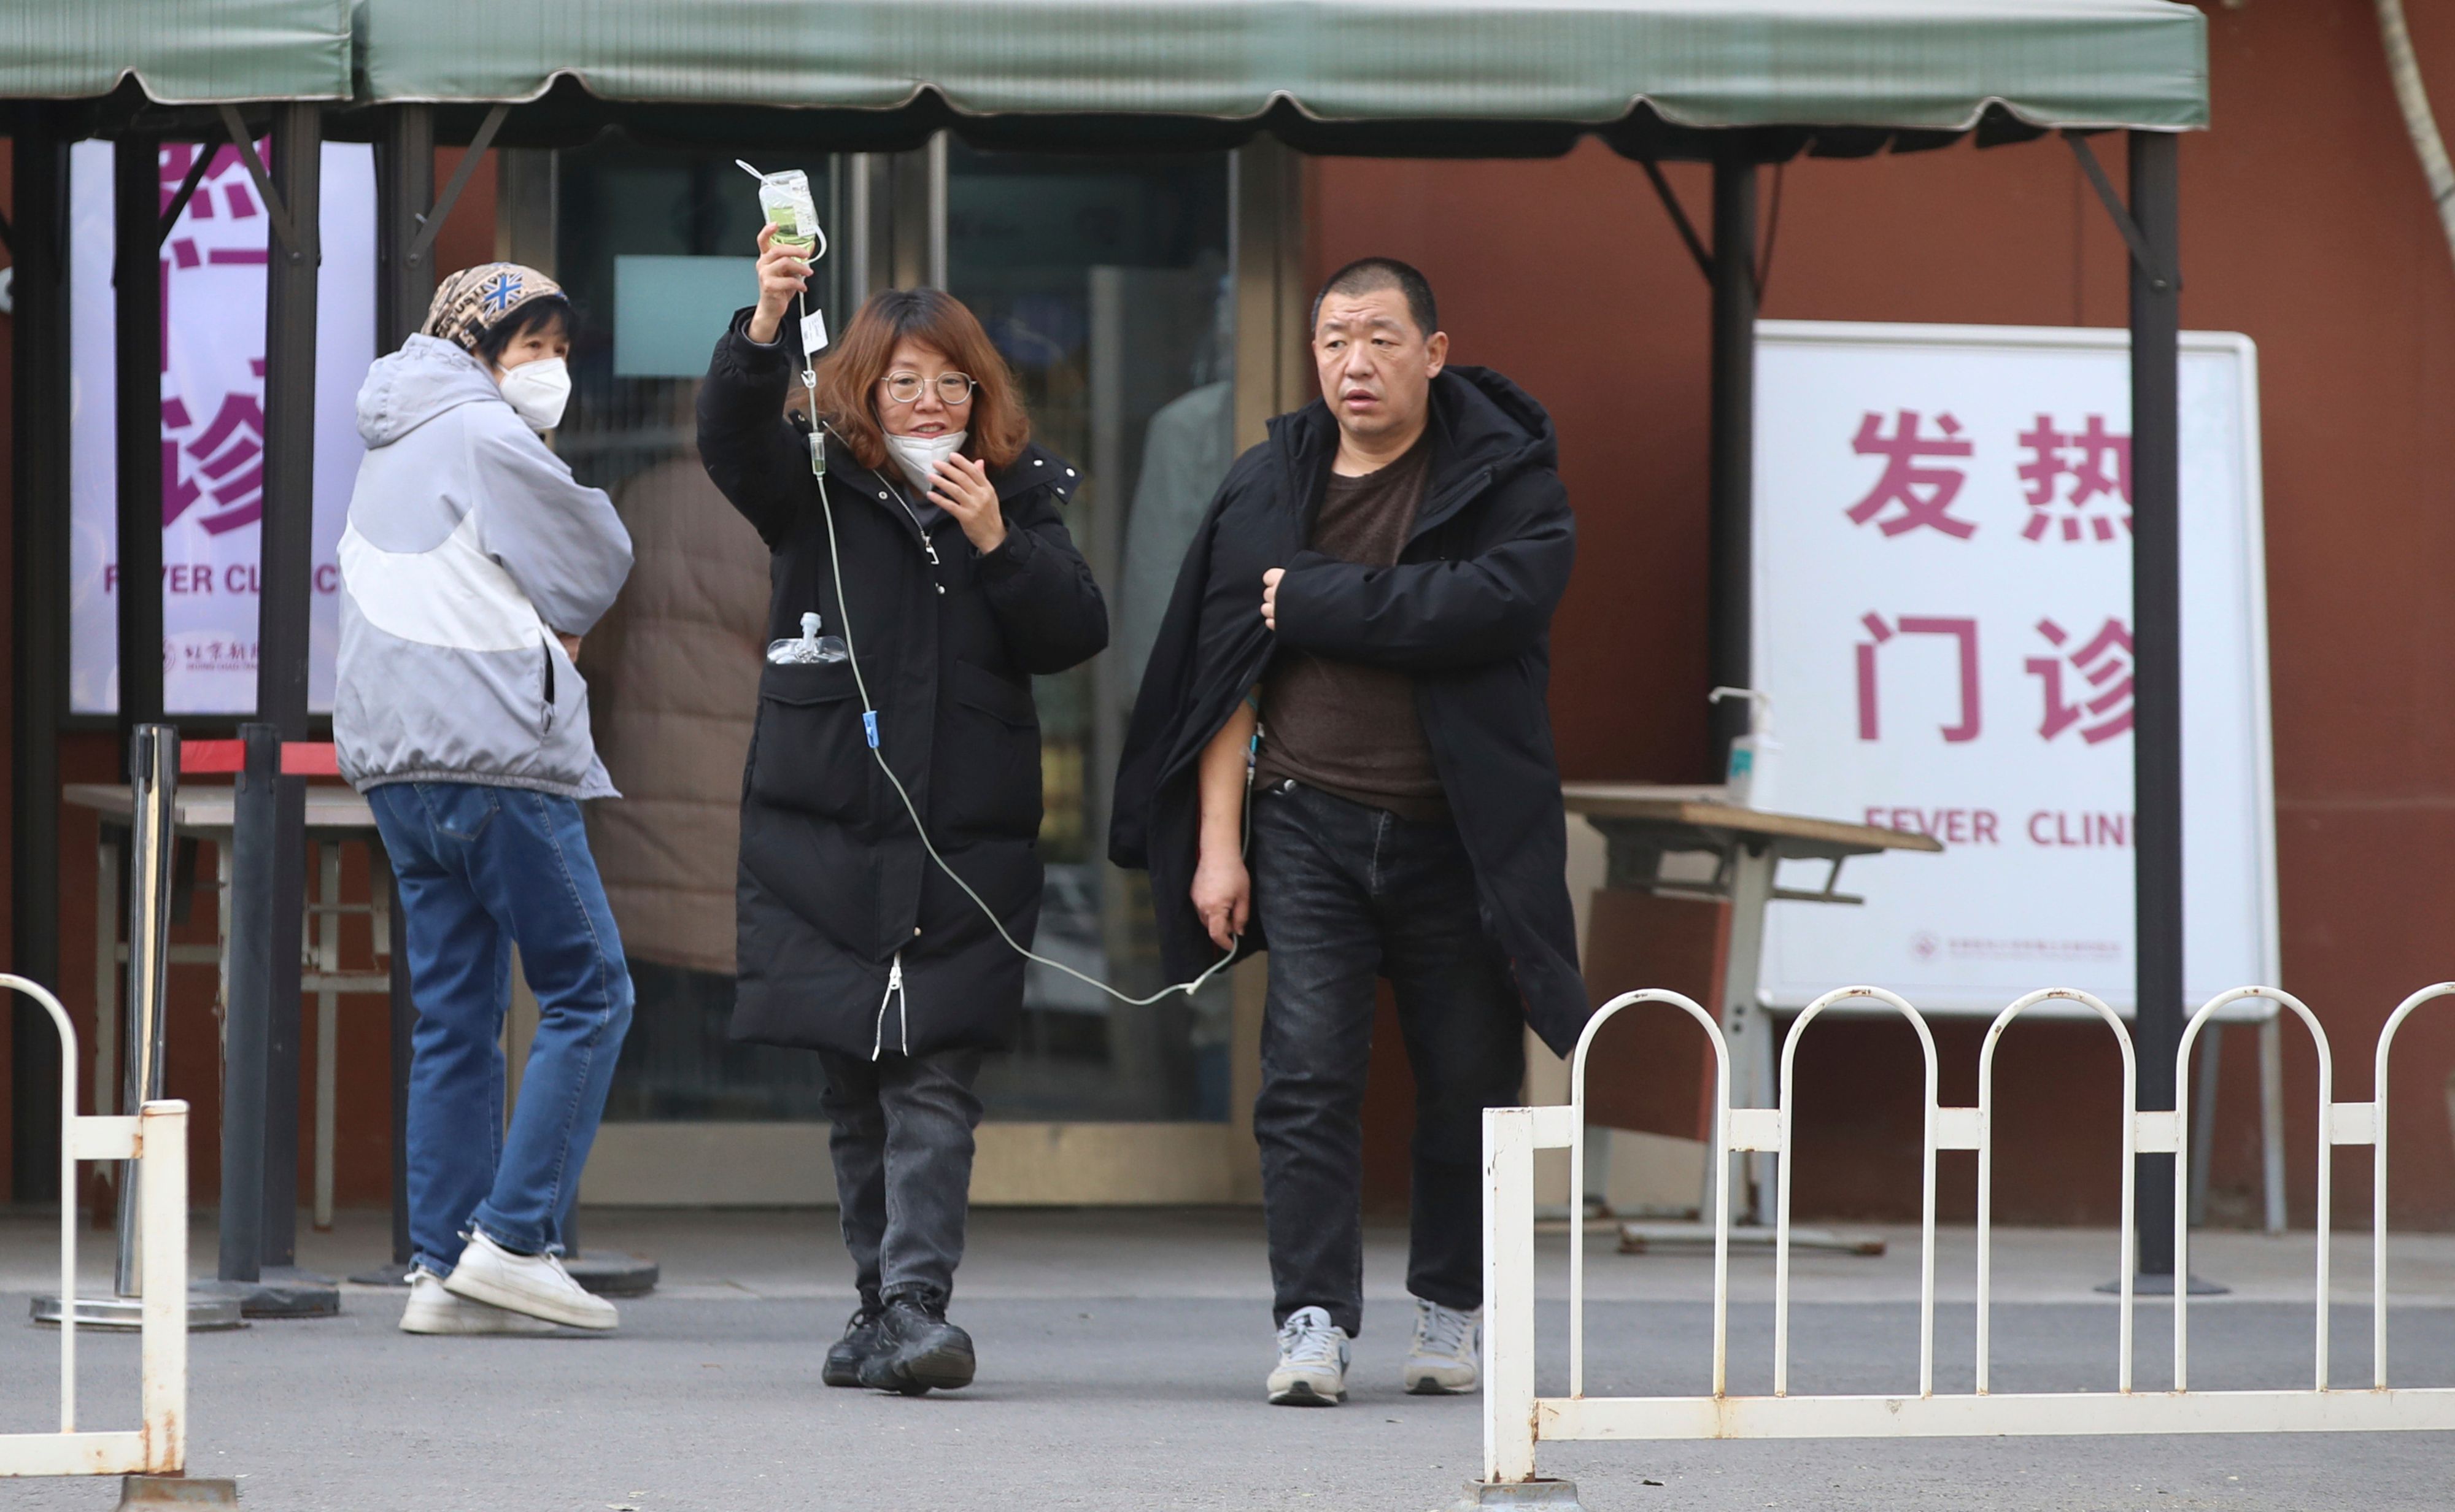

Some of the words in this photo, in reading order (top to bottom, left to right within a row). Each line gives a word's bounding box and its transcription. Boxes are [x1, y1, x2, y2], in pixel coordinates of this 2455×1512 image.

[1846, 410, 2133, 541] 发热
[104, 564, 213, 594] FER
[225, 564, 337, 594] CLC
[1856, 612, 2134, 744] 门诊
[2028, 811, 2136, 846] CLIN
